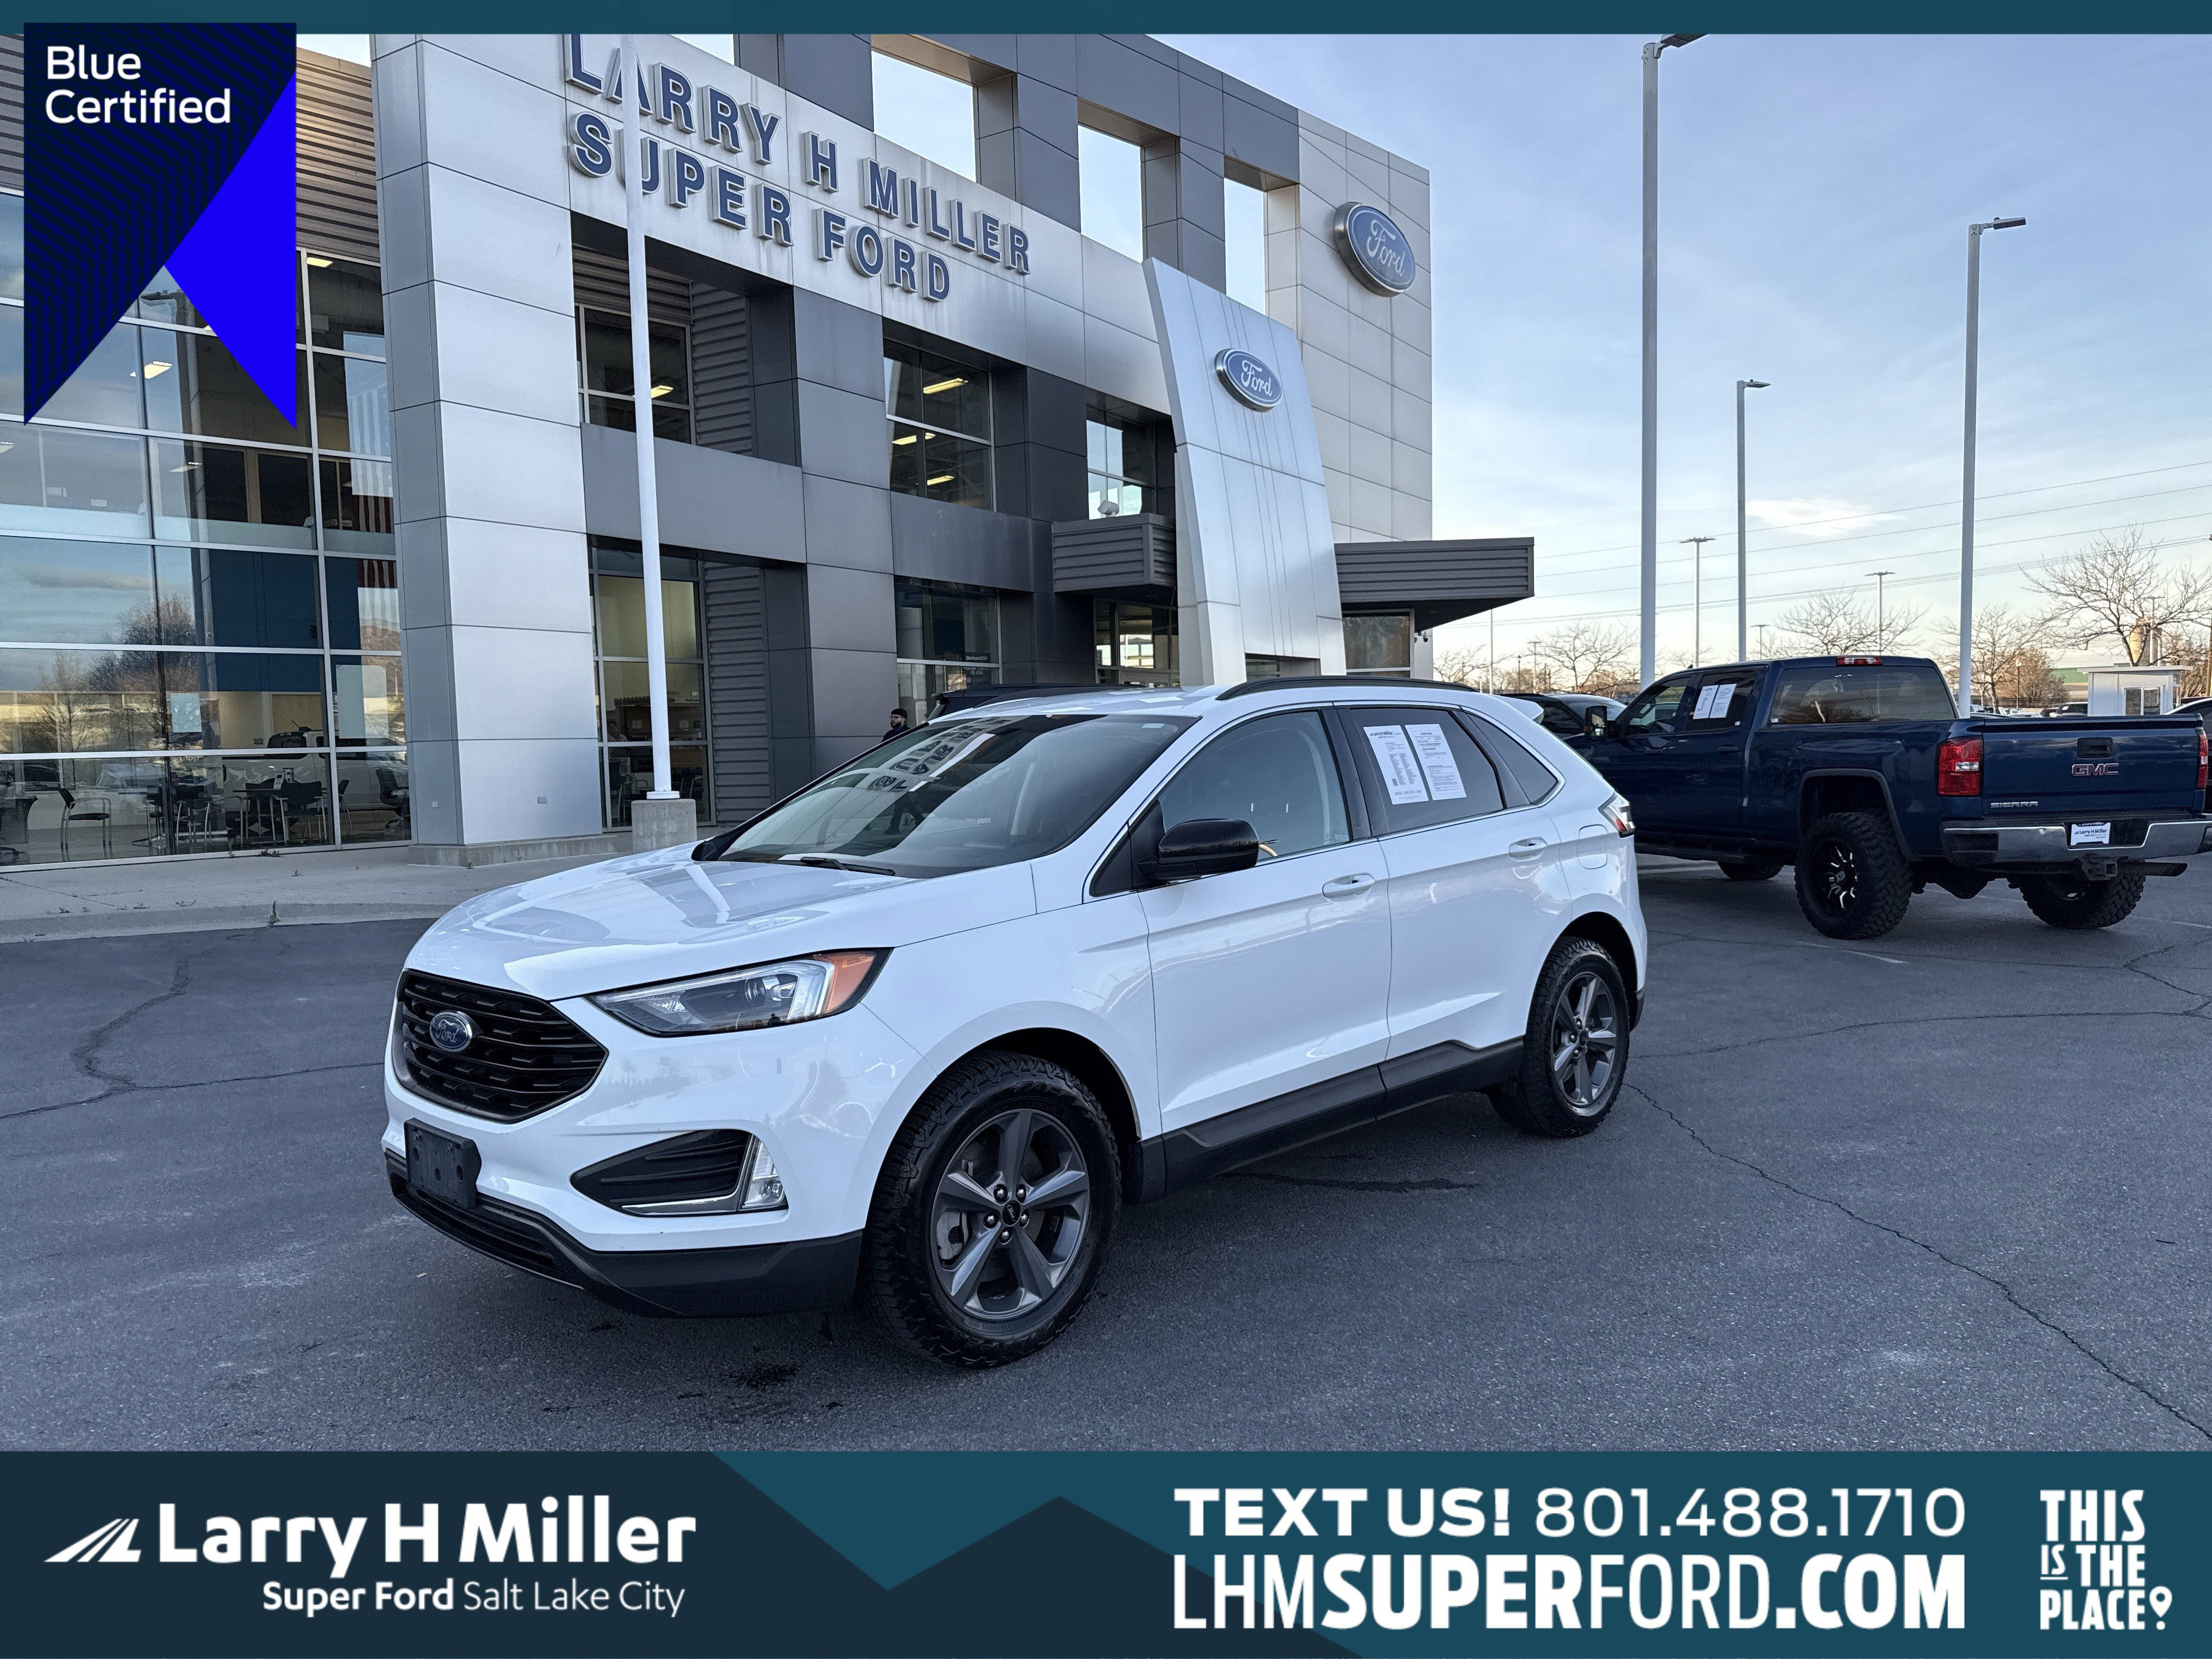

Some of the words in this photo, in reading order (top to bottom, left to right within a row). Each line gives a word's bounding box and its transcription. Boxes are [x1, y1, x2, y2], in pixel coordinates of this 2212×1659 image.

[804, 131, 839, 194] H
[862, 157, 1031, 275] MILLER
[816, 207, 950, 303] FORD
[1366, 219, 1406, 278] Ford
[1240, 360, 1273, 397] Ford
[2072, 763, 2119, 776] GMC
[436, 1019, 459, 1043] Ford
